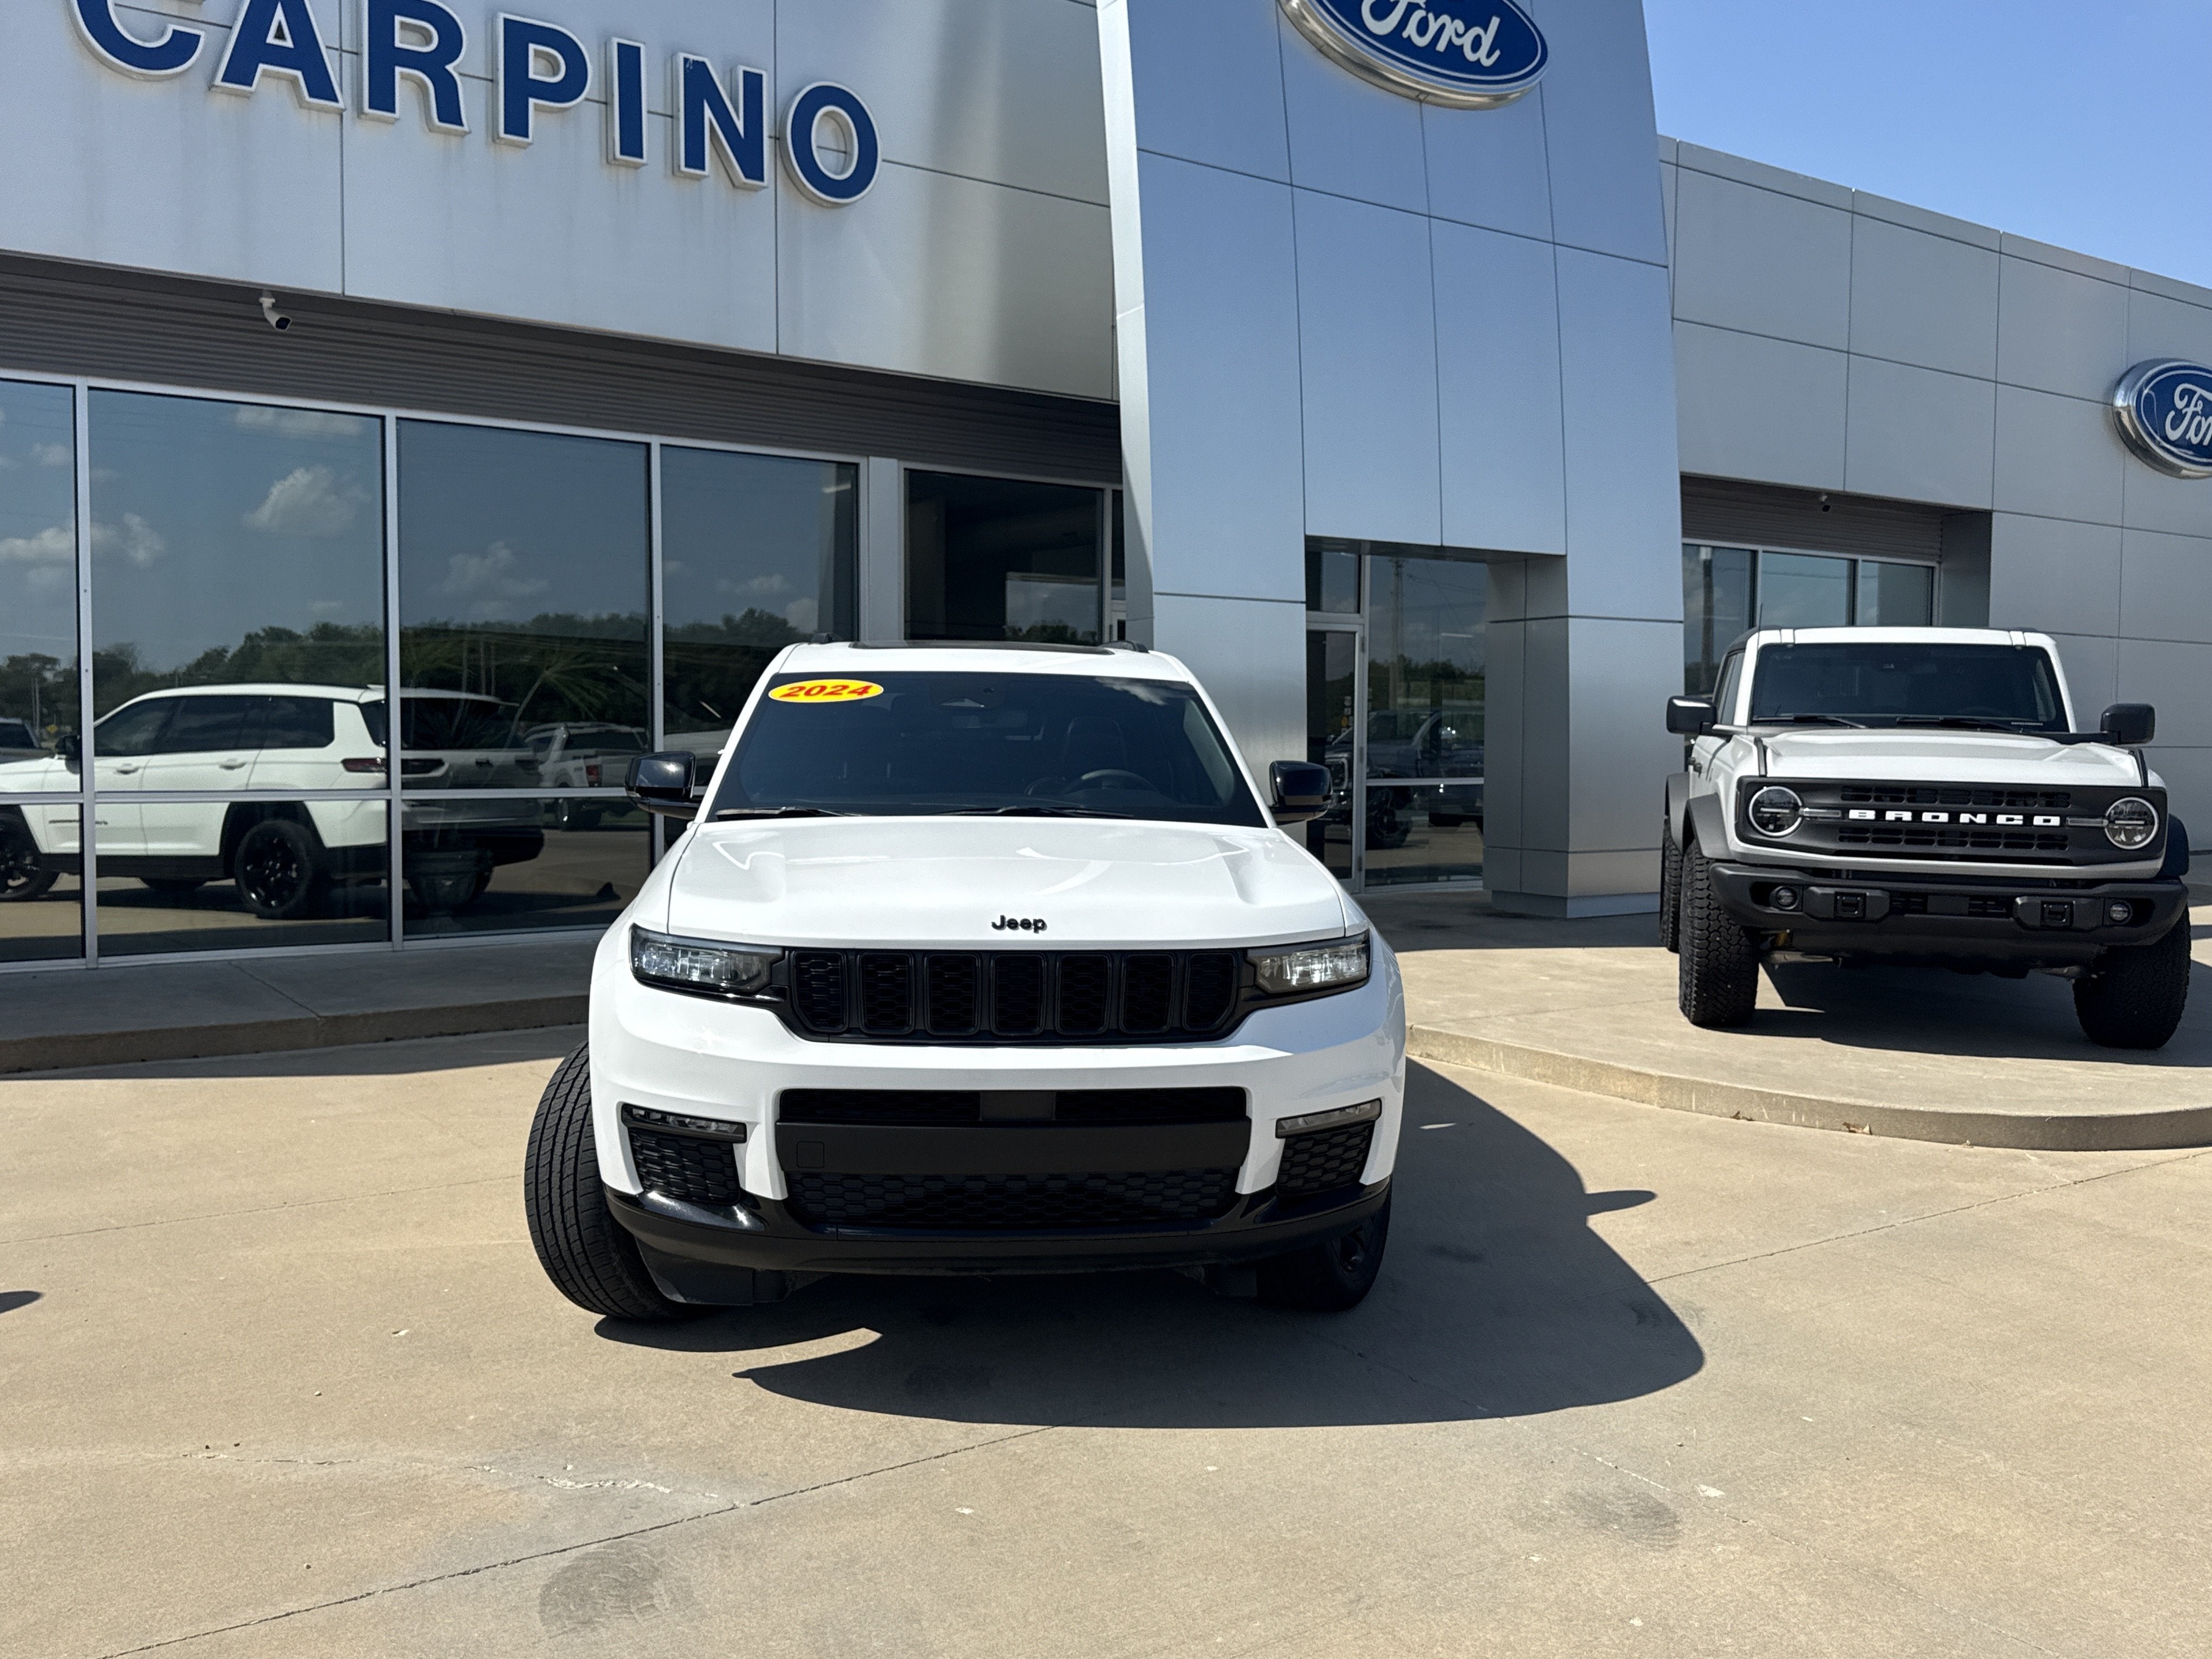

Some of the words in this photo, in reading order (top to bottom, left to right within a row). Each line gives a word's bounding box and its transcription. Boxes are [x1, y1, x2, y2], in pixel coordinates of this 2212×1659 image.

[780, 685, 873, 698] 2024
[1849, 809, 2060, 826] BRONCO
[991, 915, 1047, 934] Jeep
